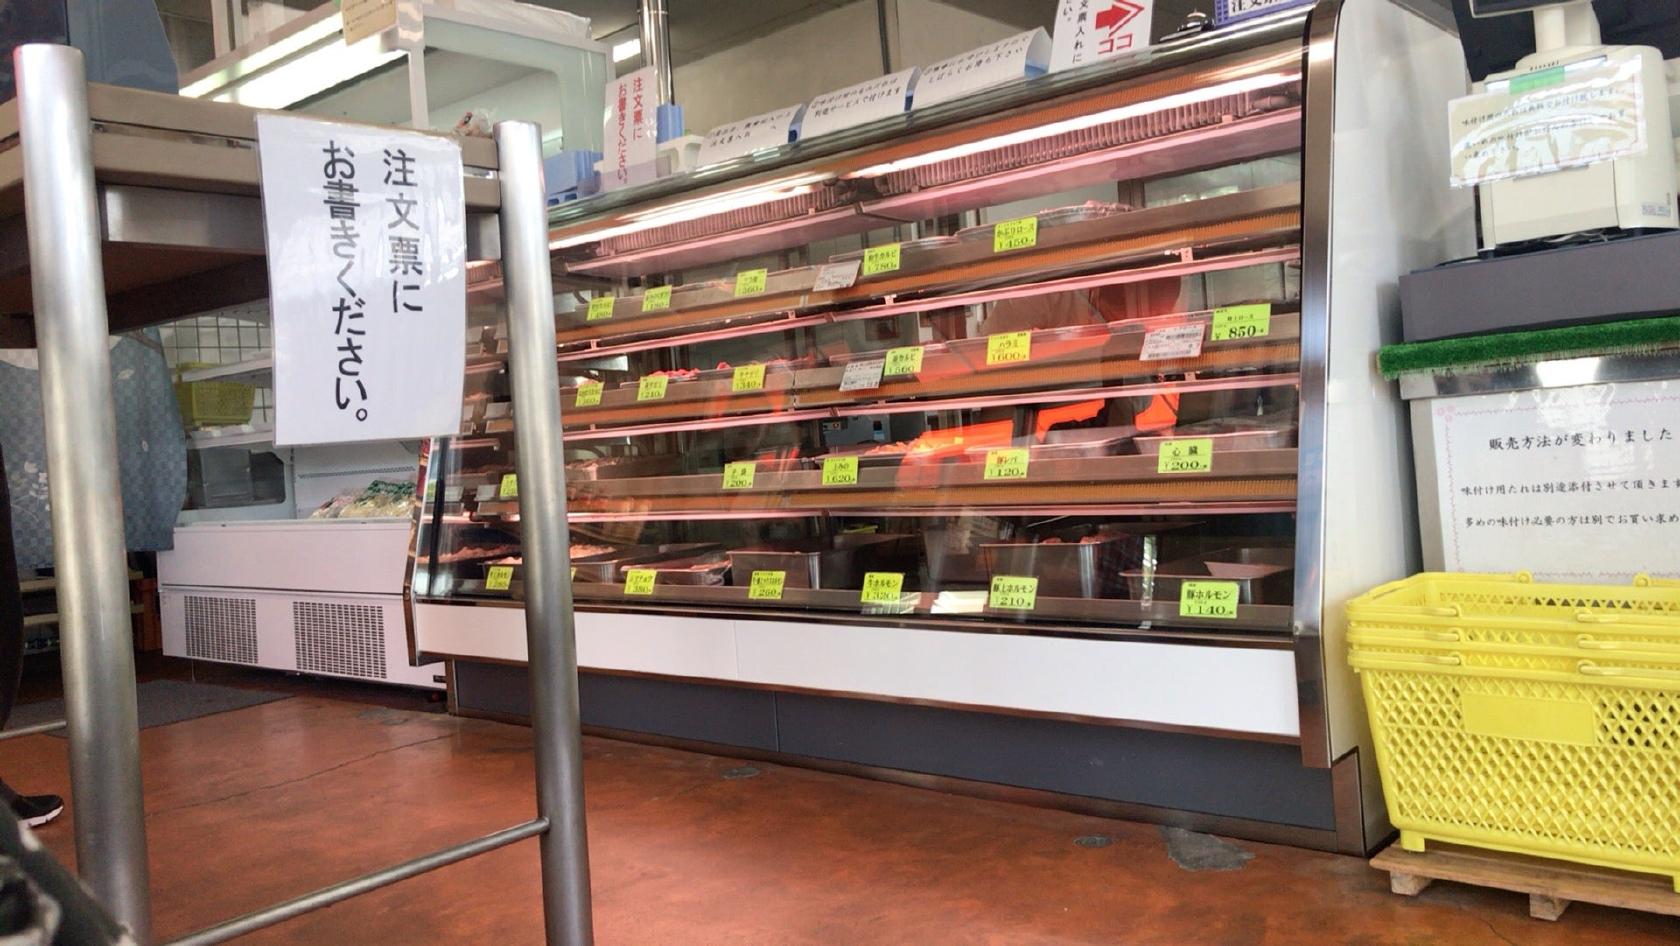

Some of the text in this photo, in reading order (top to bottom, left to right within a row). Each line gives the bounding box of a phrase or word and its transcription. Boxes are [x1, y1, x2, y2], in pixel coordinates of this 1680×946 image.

[1097, 33, 1134, 54] ココ
[617, 83, 628, 185] お書きください。
[632, 77, 643, 141] 注文票に
[383, 148, 424, 314] 注文票に
[321, 140, 369, 422] お書きください。
[1489, 427, 1673, 451] 販売方法が変わりました
